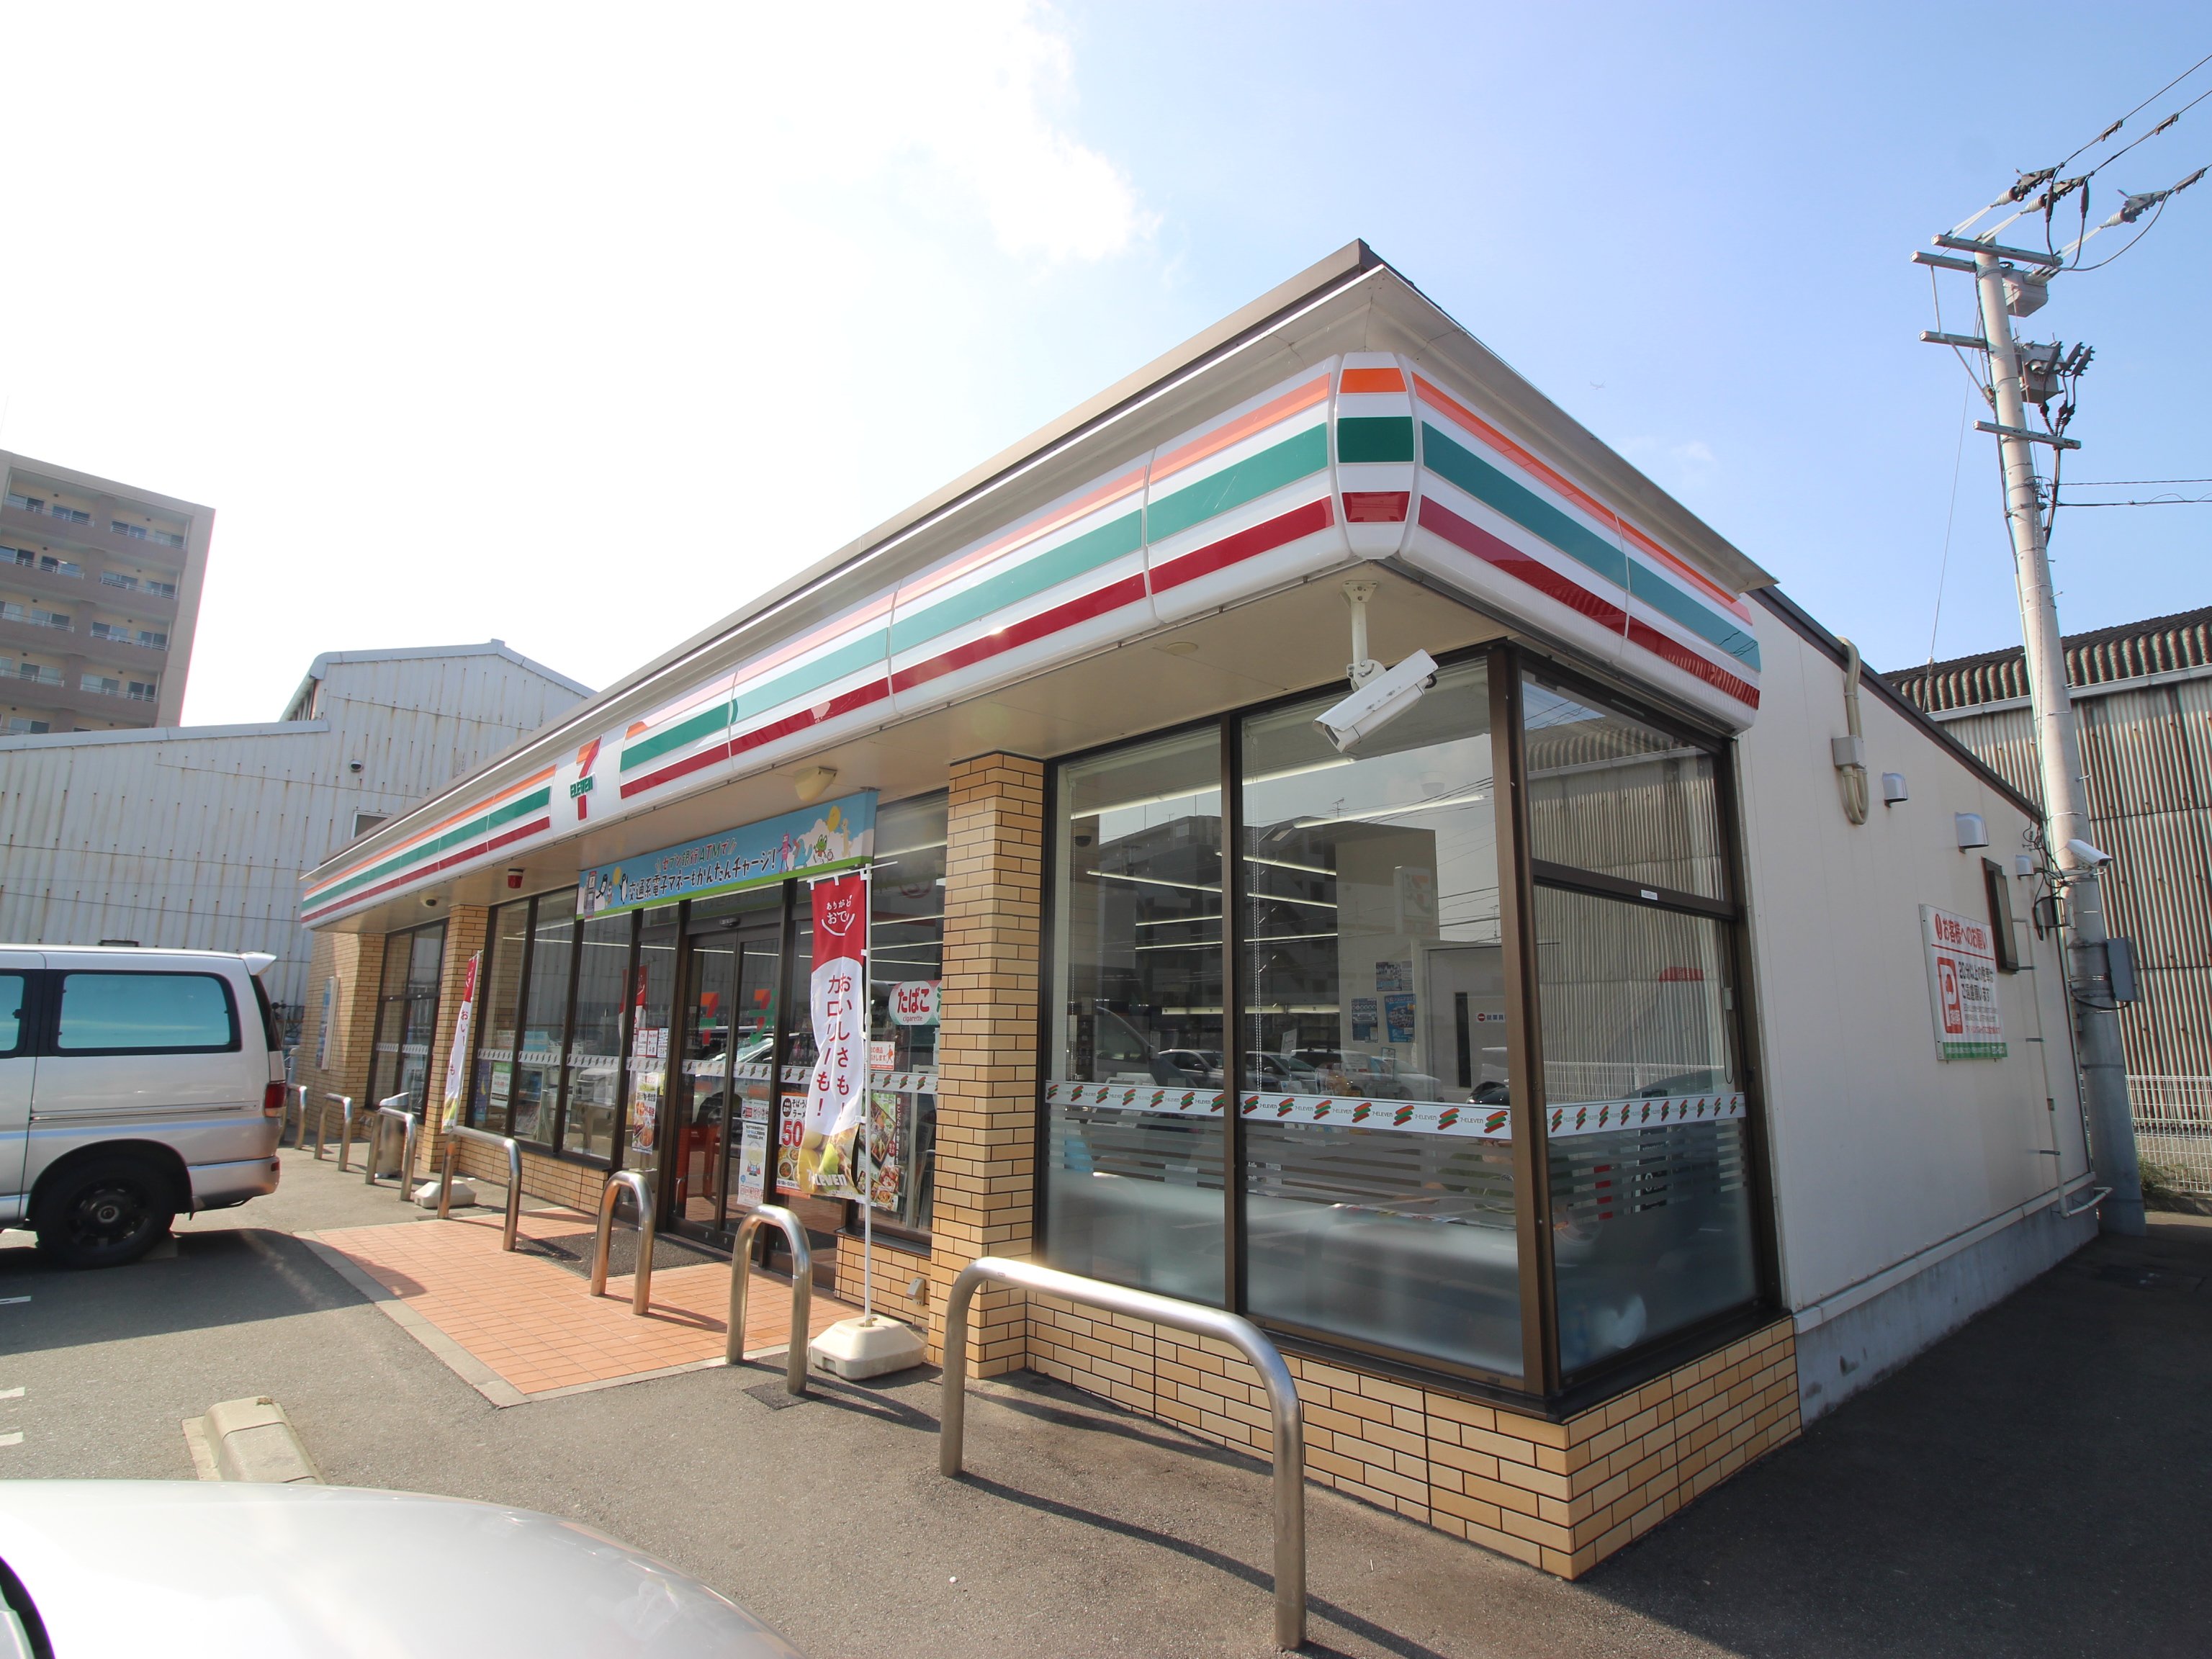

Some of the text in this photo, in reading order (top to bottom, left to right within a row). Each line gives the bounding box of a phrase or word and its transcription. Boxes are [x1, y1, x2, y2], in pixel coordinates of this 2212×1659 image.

[662, 841, 729, 871] セブン銀行ATMで
[629, 848, 776, 902] 交通系電子マネーもかんたんチャージ!
[897, 986, 930, 1014] たばこ
[902, 1015, 923, 1023] cigarette
[782, 1119, 805, 1148] 50
